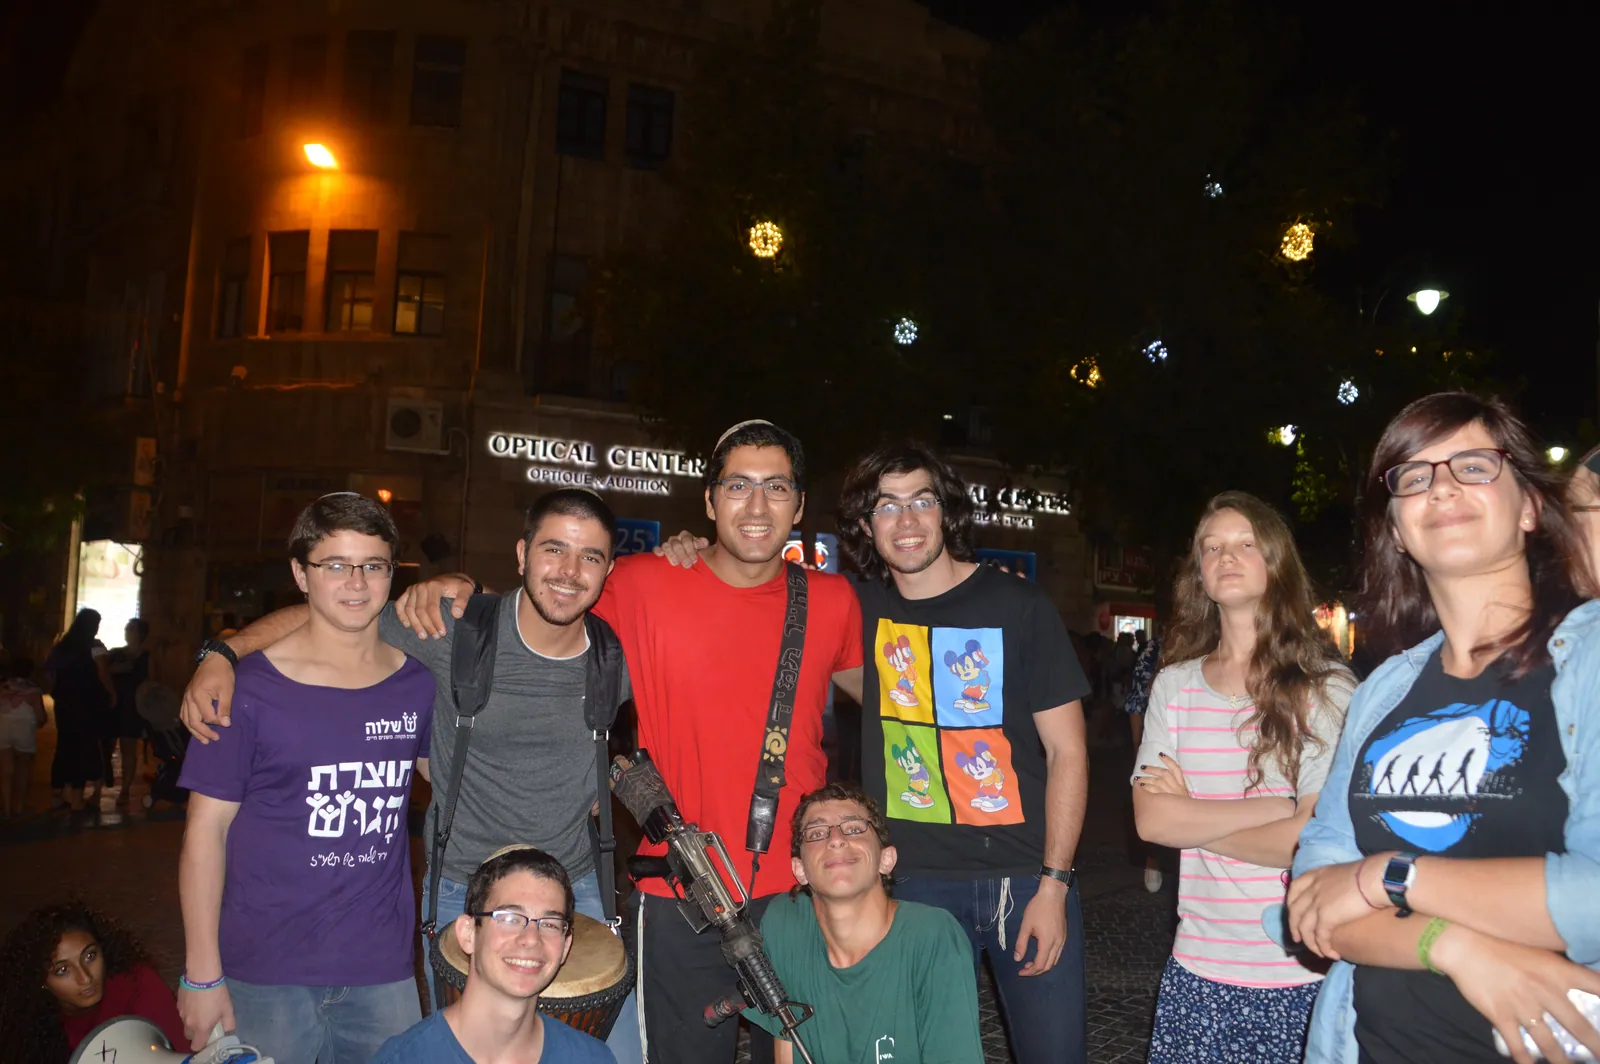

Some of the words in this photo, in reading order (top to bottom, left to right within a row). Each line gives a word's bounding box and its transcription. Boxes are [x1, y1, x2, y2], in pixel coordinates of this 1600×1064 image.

[490, 434, 597, 464] OPTICAL
[607, 446, 706, 477] CENTER
[528, 467, 593, 485] OPTIQUE
[607, 474, 671, 495] AUDITION
[773, 647, 802, 721] תמיד
[365, 718, 402, 735] שלוה
[307, 760, 413, 791] תוצרת
